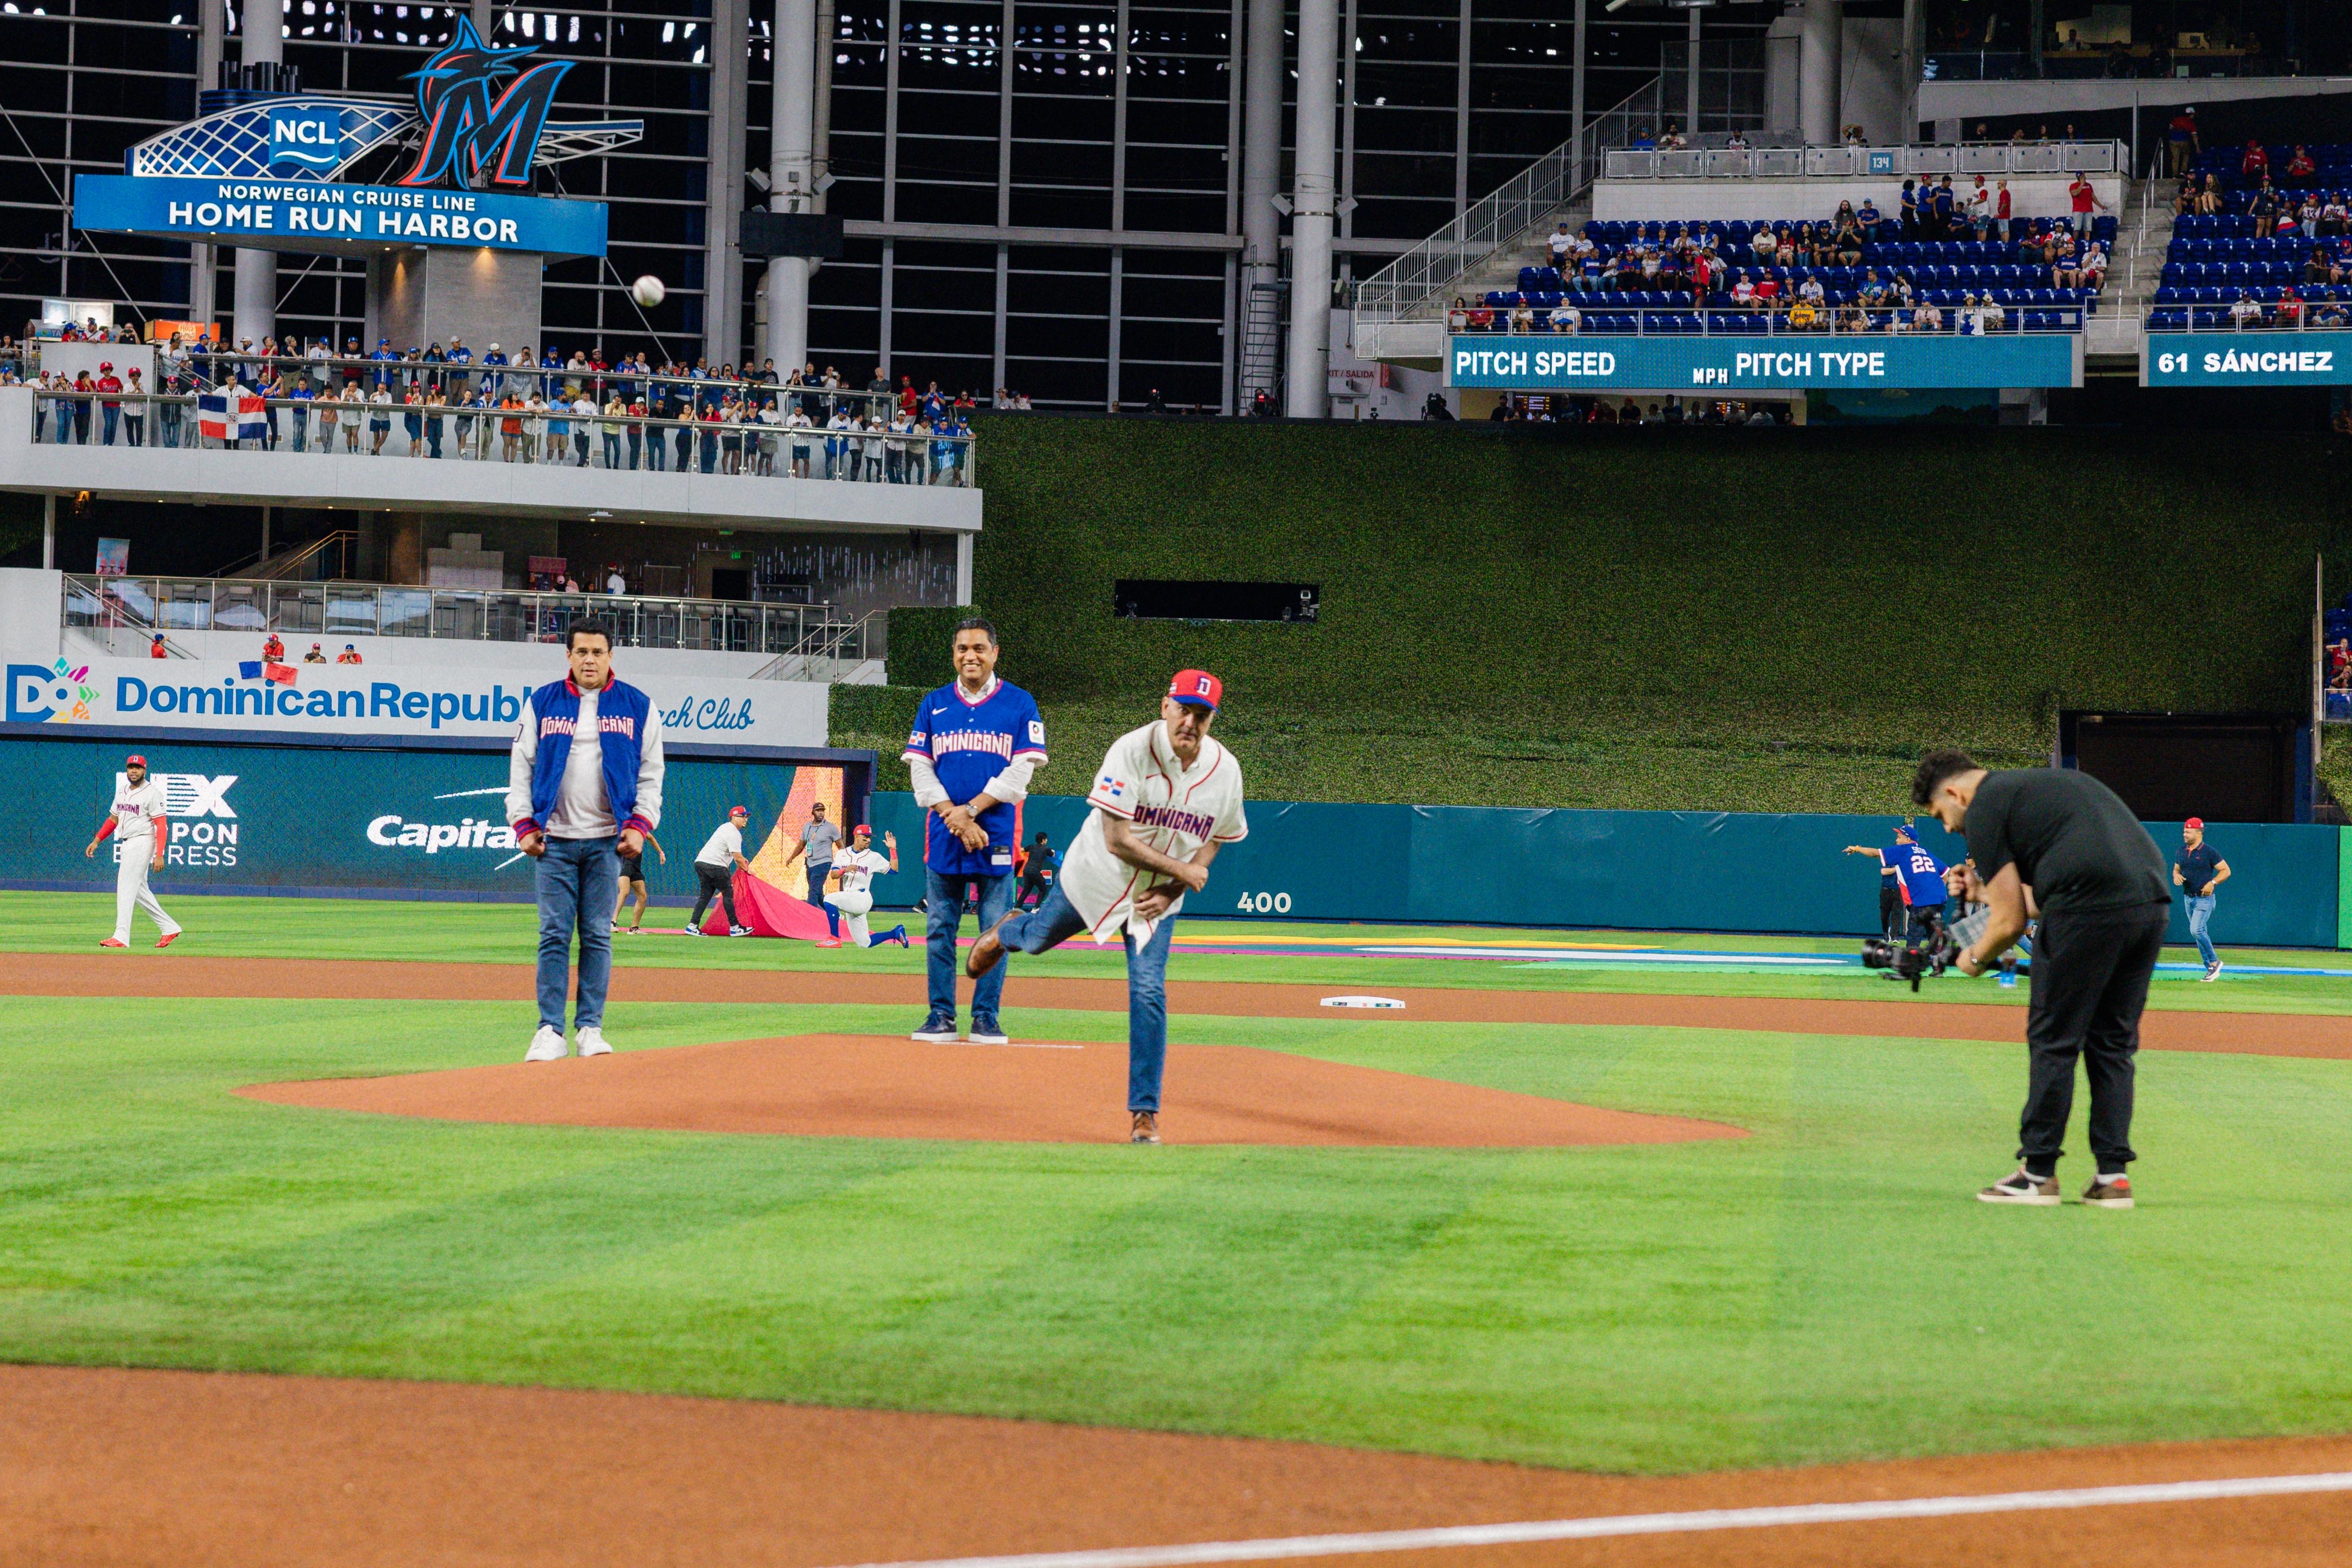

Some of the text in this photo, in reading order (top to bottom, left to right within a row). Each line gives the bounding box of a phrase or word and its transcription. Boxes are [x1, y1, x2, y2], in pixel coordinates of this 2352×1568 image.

[275, 119, 335, 144] NCL
[1873, 157, 1889, 168] 134
[219, 185, 475, 211] NORWEGIAN CRUISE LINE
[170, 201, 518, 243] HOME RUN HARBOR
[1456, 352, 1615, 375] PITCH SPEED
[1736, 353, 1885, 376] PITCH TYPE
[2158, 348, 2333, 372] 61 SÁNCHEZ
[1693, 368, 1729, 385] MPH
[1197, 676, 1212, 696] D
[116, 677, 365, 718] Dominican
[370, 682, 532, 729] Repub
[697, 697, 755, 730] Club
[116, 804, 140, 816] MINICANA
[367, 815, 521, 854] Capita
[1133, 804, 1215, 843] OMINICANA
[113, 844, 237, 866] ERESS
[1911, 846, 1927, 855] SOTO
[1910, 855, 1936, 874] 22
[1237, 891, 1292, 913] 400
